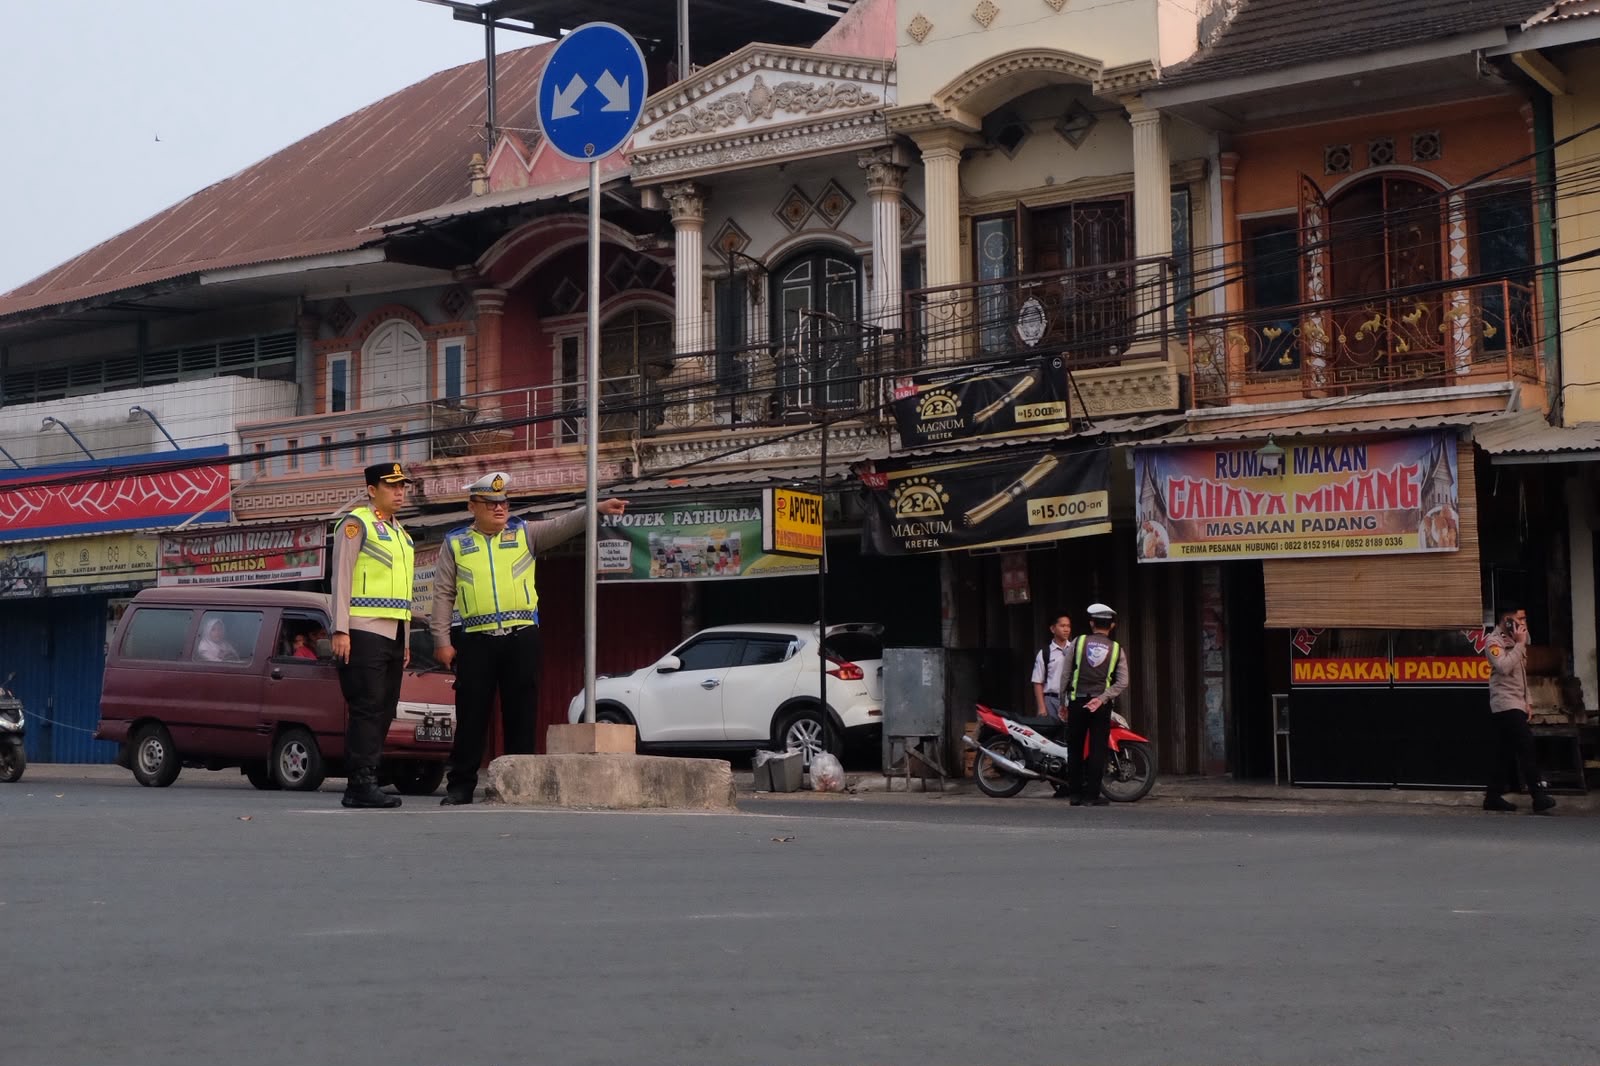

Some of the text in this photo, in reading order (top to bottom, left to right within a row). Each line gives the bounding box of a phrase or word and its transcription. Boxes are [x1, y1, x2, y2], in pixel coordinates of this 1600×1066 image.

[925, 400, 953, 415] 234
[916, 418, 965, 434] MAGNUM
[927, 431, 953, 441] KRETEK
[1293, 444, 1367, 475] MAKAN
[1167, 463, 1419, 520] CAHAYA MINANG
[789, 495, 821, 525] APOTEK
[901, 494, 936, 512] 234
[600, 507, 762, 528] APOTEK FATHURRA
[1206, 515, 1377, 537] MASAKAN PADANG
[890, 519, 953, 538] MAGNUM
[183, 530, 295, 555] POM MINI DIGITAL
[904, 538, 940, 550] KRETEK
[1181, 544, 1207, 554] TERIMA
[1208, 543, 1242, 553] PESANAN
[1245, 541, 1278, 552] HUBUNGI
[1284, 540, 1302, 550] 0822
[1303, 540, 1321, 549] 8152
[1322, 539, 1340, 549] 9164
[1345, 538, 1364, 548] 0852
[1365, 538, 1383, 547] 8189
[1384, 537, 1403, 547] 0336
[1295, 661, 1493, 680] MASAKAN PADANG
